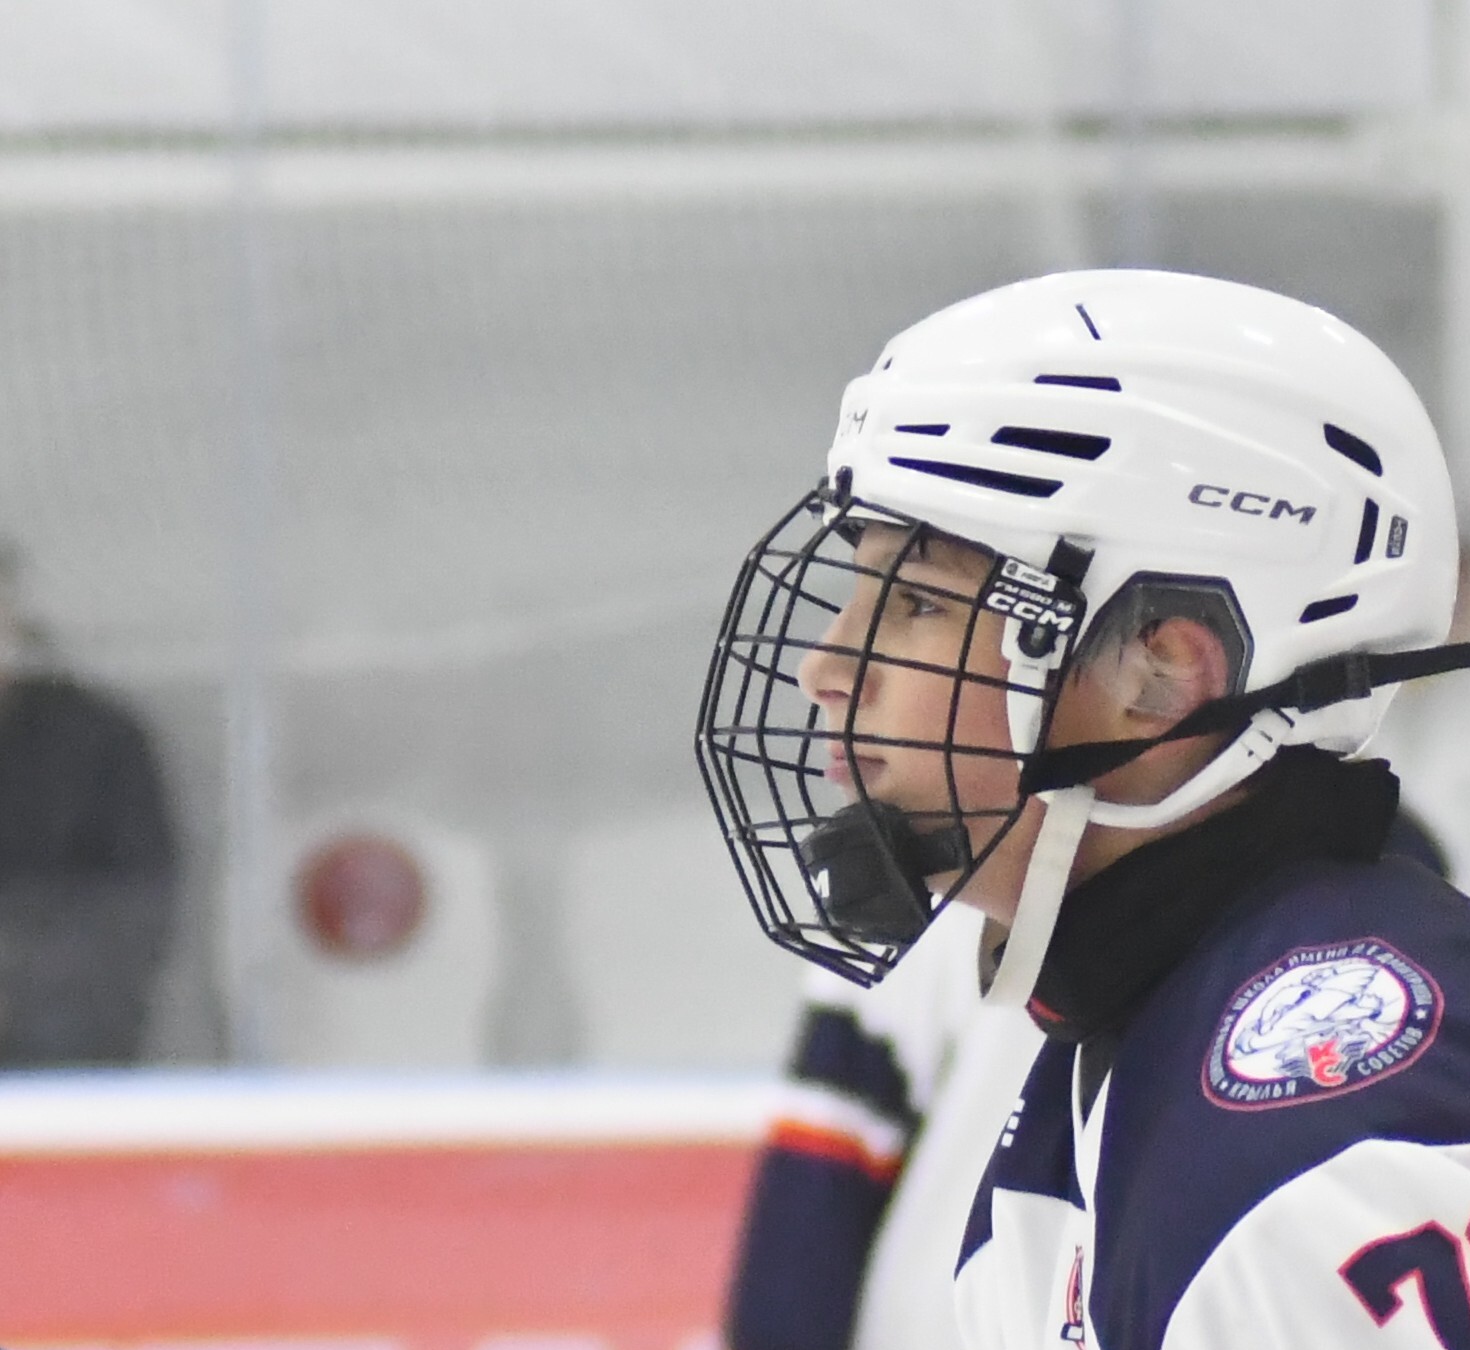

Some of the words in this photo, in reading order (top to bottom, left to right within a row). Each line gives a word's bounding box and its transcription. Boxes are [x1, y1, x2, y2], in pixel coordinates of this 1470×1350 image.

[1187, 484, 1318, 527] CCM
[986, 592, 1075, 632] CCM
[1228, 1080, 1297, 1102] КРЫЛЬЯ
[1356, 1025, 1424, 1076] СОВЕТОВ
